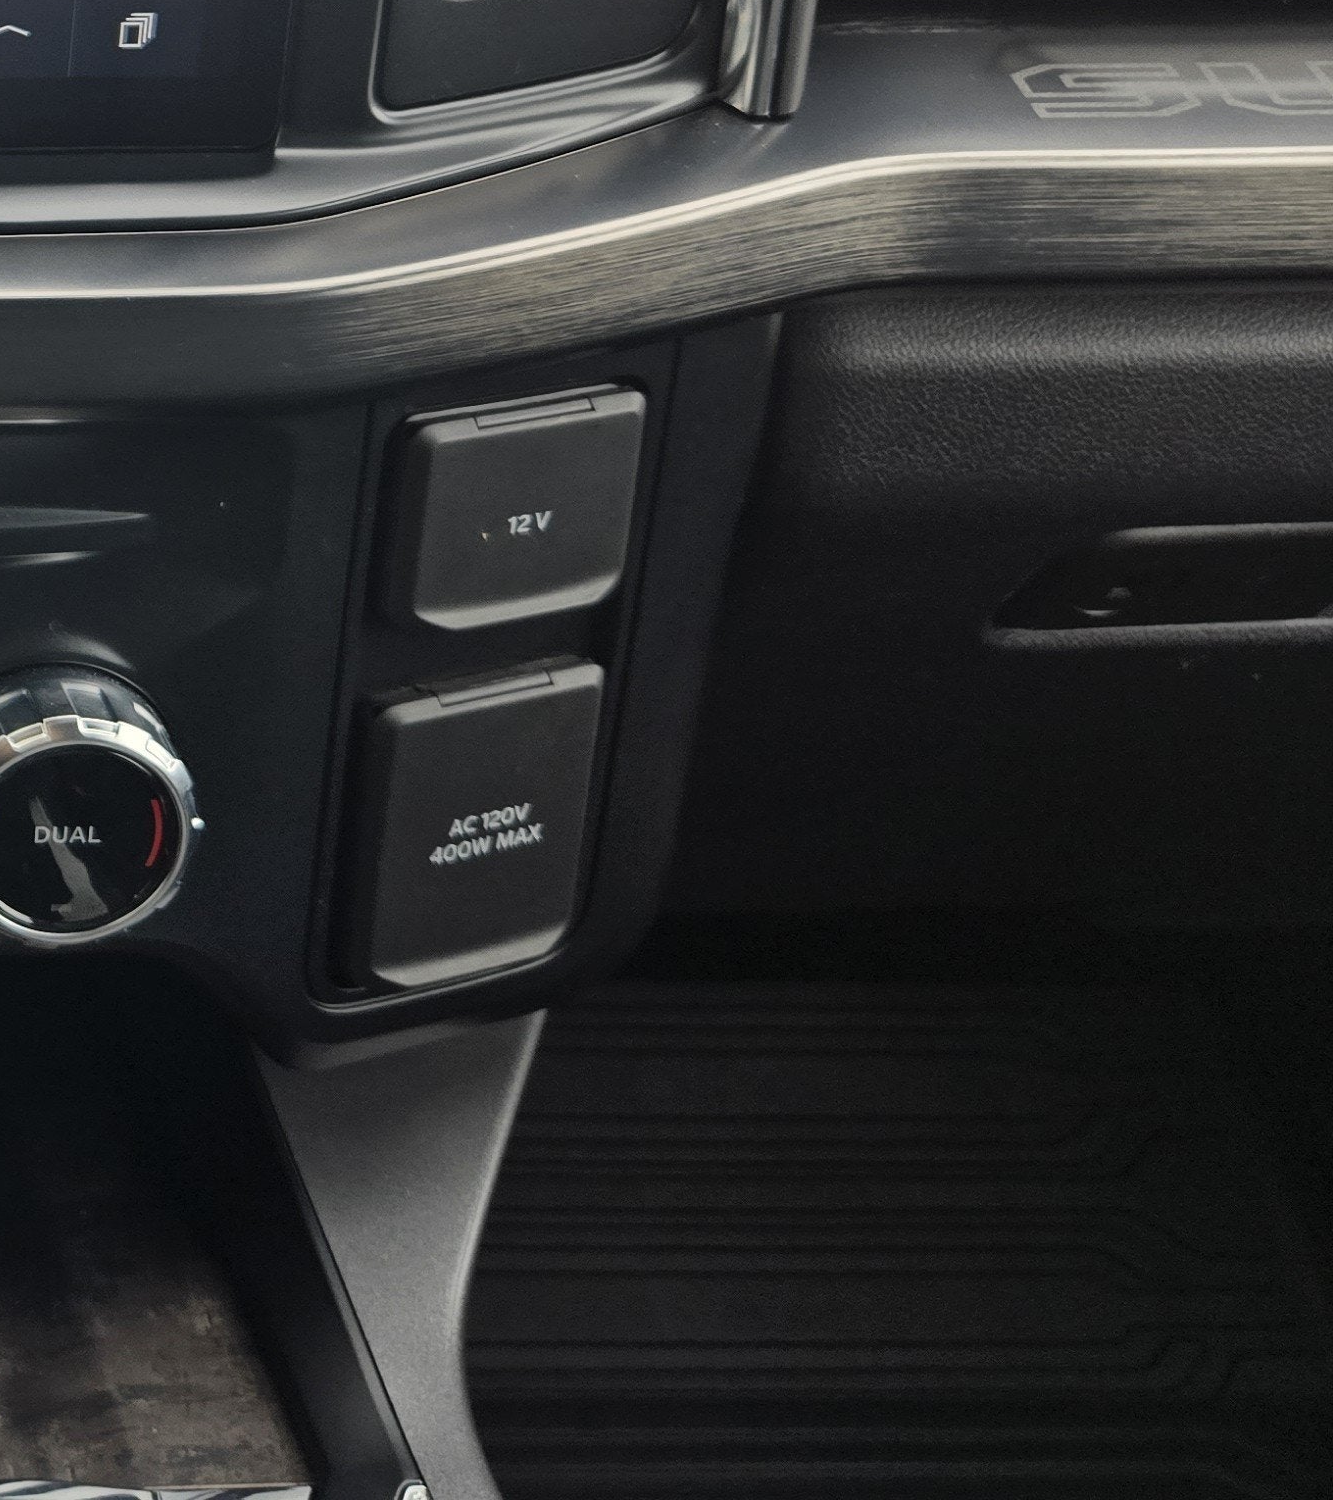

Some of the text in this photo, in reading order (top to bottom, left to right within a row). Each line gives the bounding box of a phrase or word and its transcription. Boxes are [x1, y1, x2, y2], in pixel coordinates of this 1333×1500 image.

[33, 825, 101, 845] DUAL
[448, 803, 532, 837] AC 120V
[429, 823, 544, 864] 400W MAX
